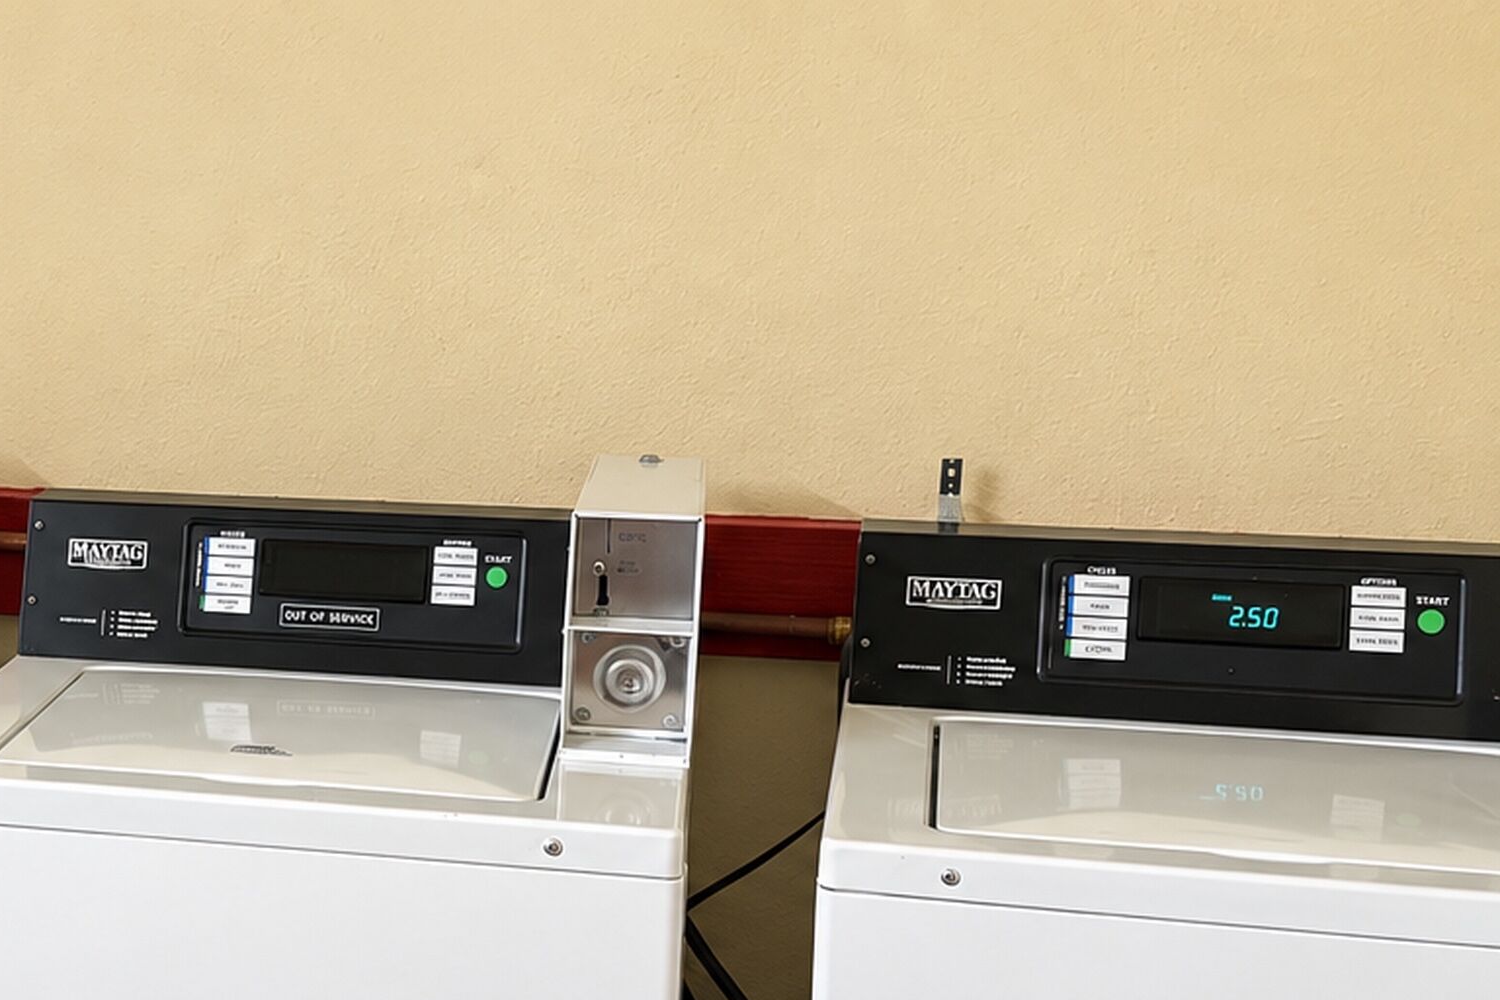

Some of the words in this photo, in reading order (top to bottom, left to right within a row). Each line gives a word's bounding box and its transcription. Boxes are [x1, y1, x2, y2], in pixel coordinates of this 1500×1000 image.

[73, 542, 143, 561] MAYTAG
[912, 580, 997, 600] MAYTAG
[284, 609, 306, 621] OUT
[309, 610, 325, 622] OF
[1228, 605, 1279, 629] 2.50
